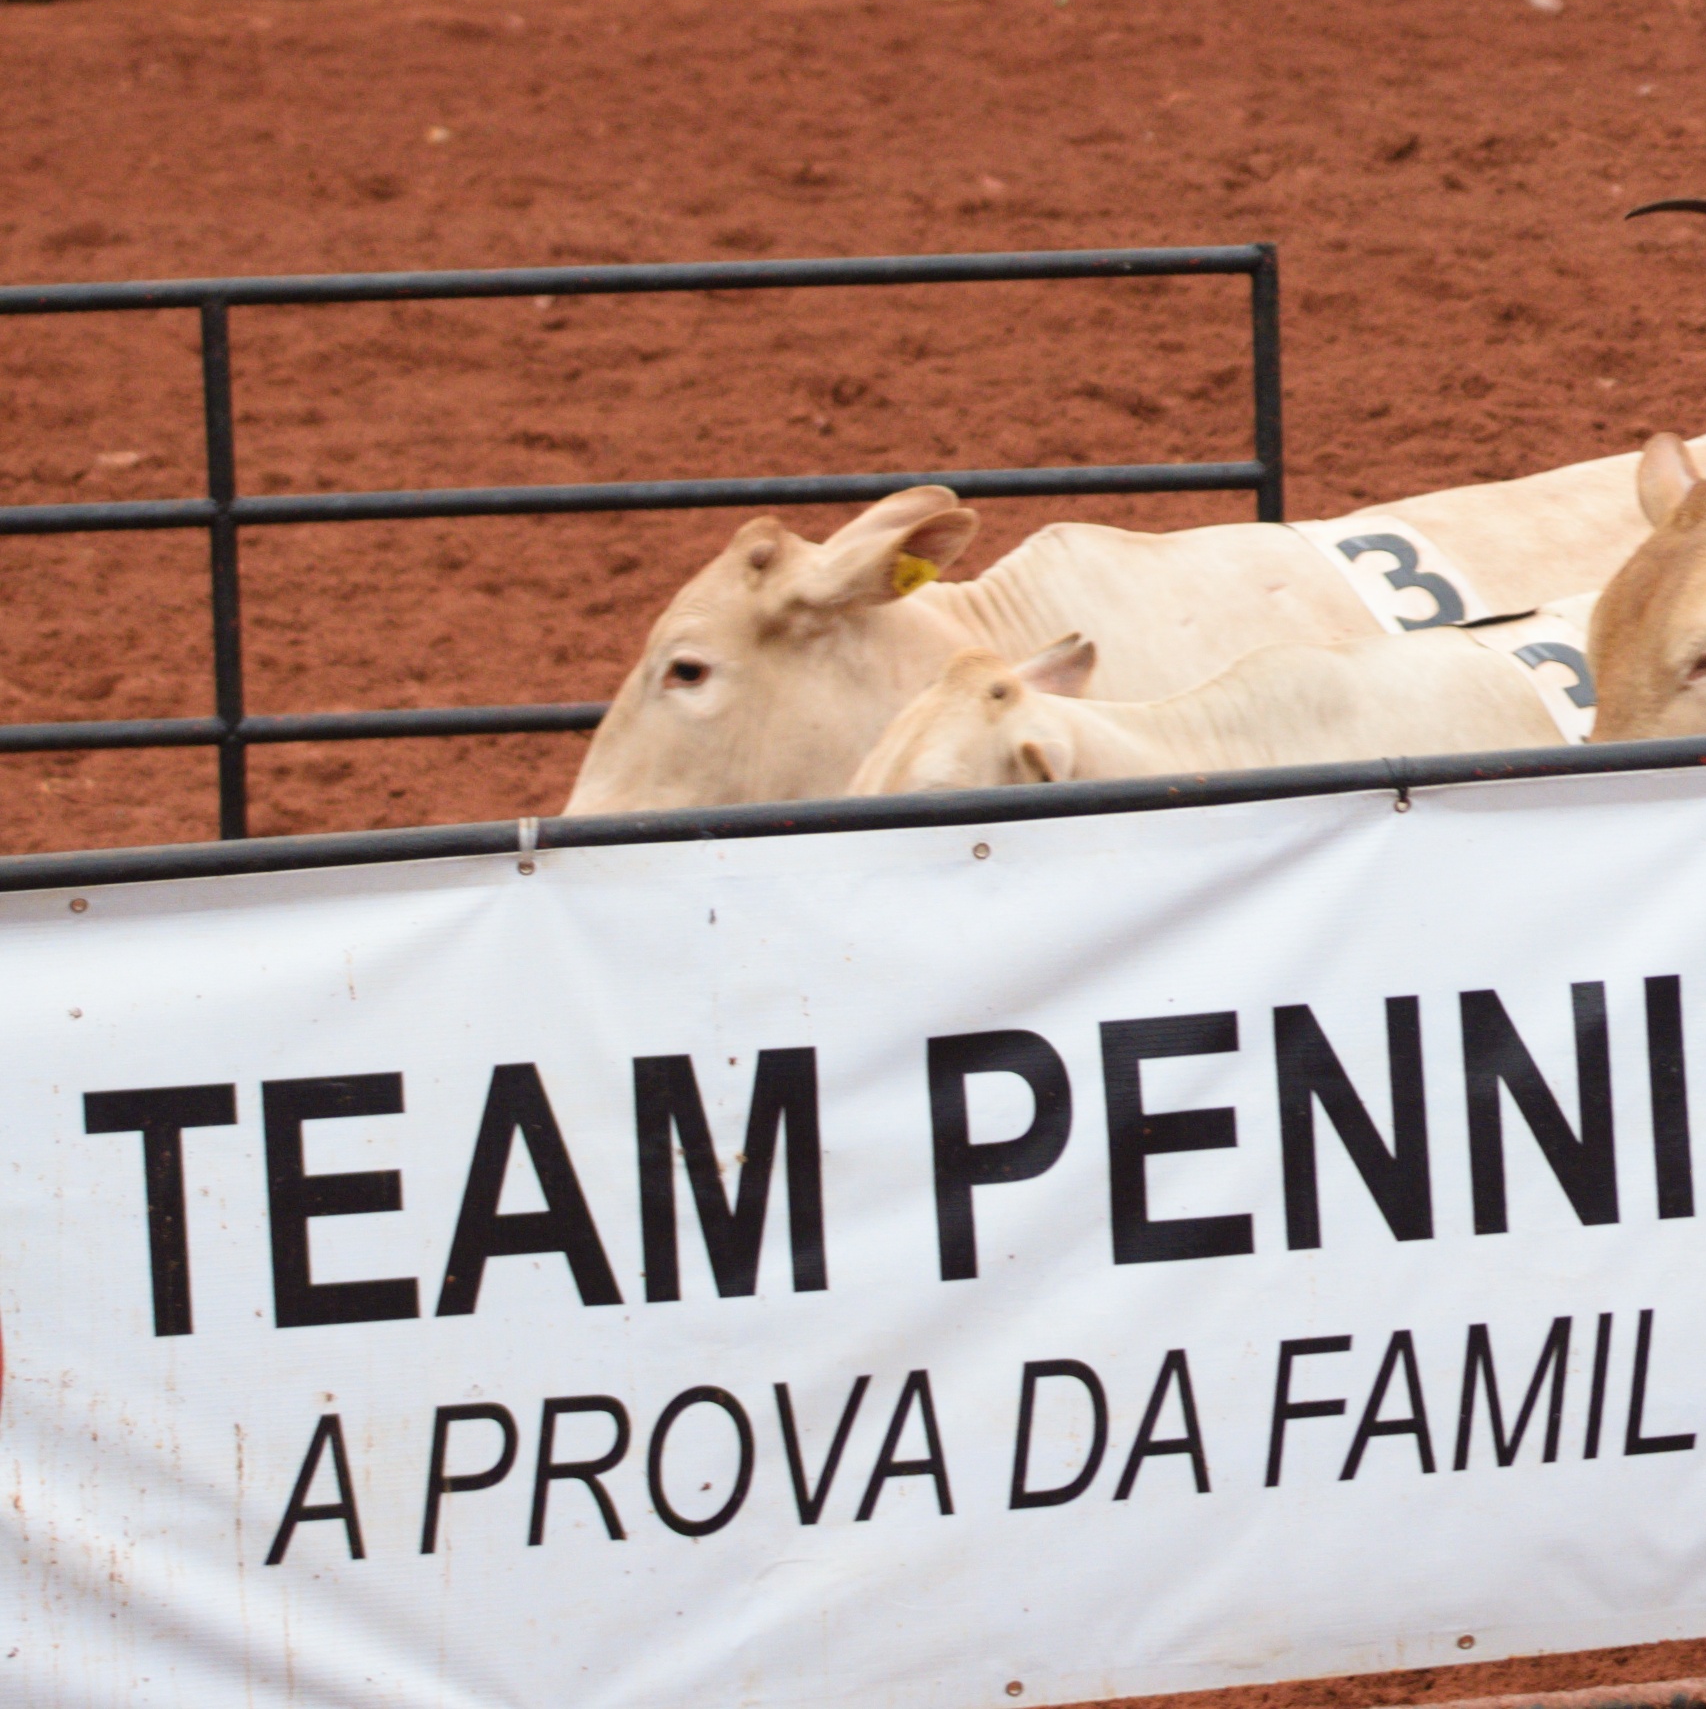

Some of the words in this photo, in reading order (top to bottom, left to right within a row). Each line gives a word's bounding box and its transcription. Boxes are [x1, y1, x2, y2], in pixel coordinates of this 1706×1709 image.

[1335, 533, 1465, 632] 3
[82, 1044, 829, 1338] TEAM
[263, 1412, 367, 1567] A
[419, 1369, 956, 1556] PROVA
[1008, 1347, 1212, 1511] DA
